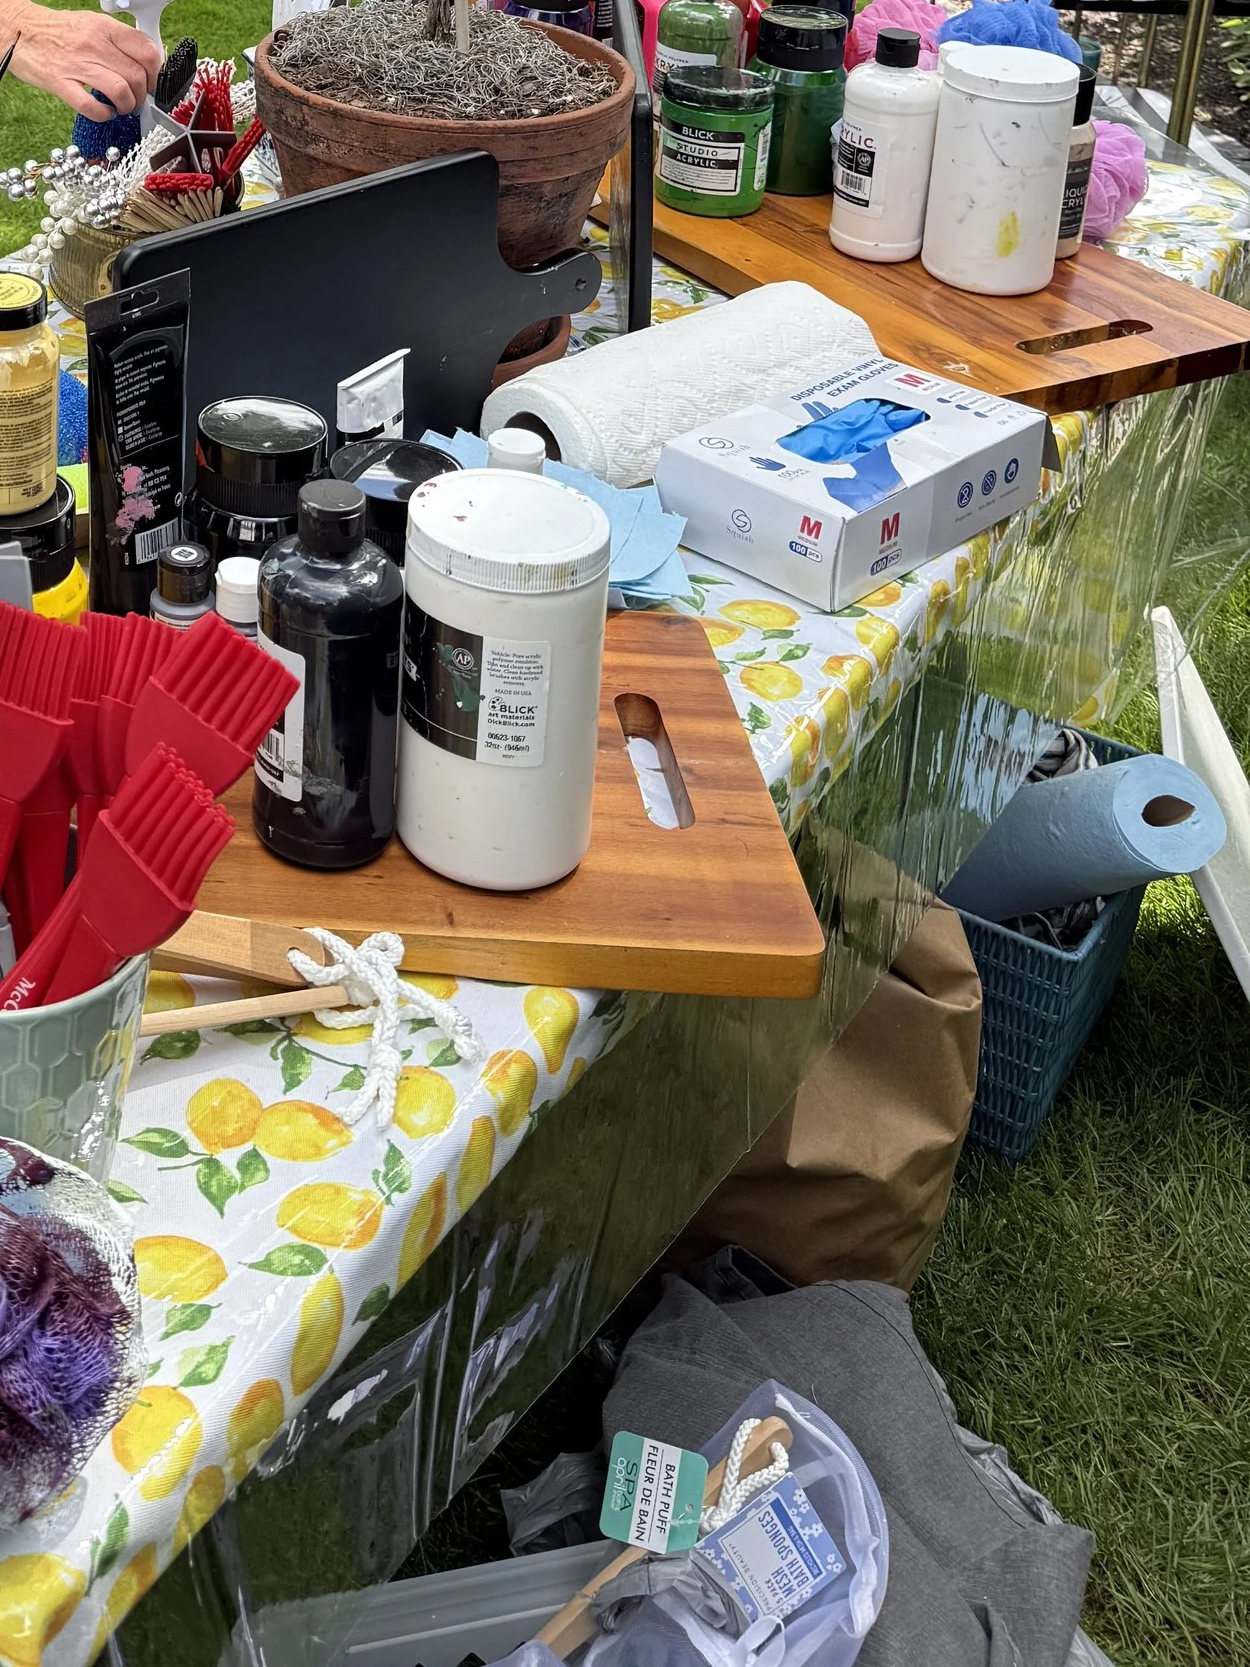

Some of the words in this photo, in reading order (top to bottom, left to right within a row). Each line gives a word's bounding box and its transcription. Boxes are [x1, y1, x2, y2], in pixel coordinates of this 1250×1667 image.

[682, 126, 715, 141] BLICK
[676, 142, 718, 157] STUDIO
[676, 153, 717, 168] ACRYLIC
[790, 370, 855, 401] DISPOSABLE
[852, 358, 884, 372] VINYL
[827, 379, 861, 397] EXAM
[857, 362, 899, 382] GLOVES
[893, 373, 932, 388] M
[726, 525, 754, 544] Squish
[799, 515, 823, 540] M
[880, 512, 900, 545] M
[791, 542, 806, 554] 100
[872, 557, 887, 573] 100
[491, 650, 512, 659] Vehicle:
[524, 653, 542, 661] acrylic
[523, 675, 540, 683] acrylic
[494, 688, 512, 696] MADE
[500, 704, 535, 715] BLICK
[500, 712, 535, 721] materials
[487, 718, 535, 728] DickBlick.com
[643, 1444, 659, 1484] FLEUR
[611, 1457, 627, 1492] april
[661, 1463, 676, 1498] BATH
[620, 1460, 638, 1511] SPA
[640, 1487, 652, 1507] DE
[635, 1509, 649, 1542] BAIN
[656, 1500, 670, 1534] PUFF
[758, 1510, 794, 1561] SPONGES
[771, 1566, 796, 1598] MESH
[785, 1557, 810, 1588] BATH
[749, 1575, 773, 1611] PRECISION
[764, 1578, 778, 1598] PACK
